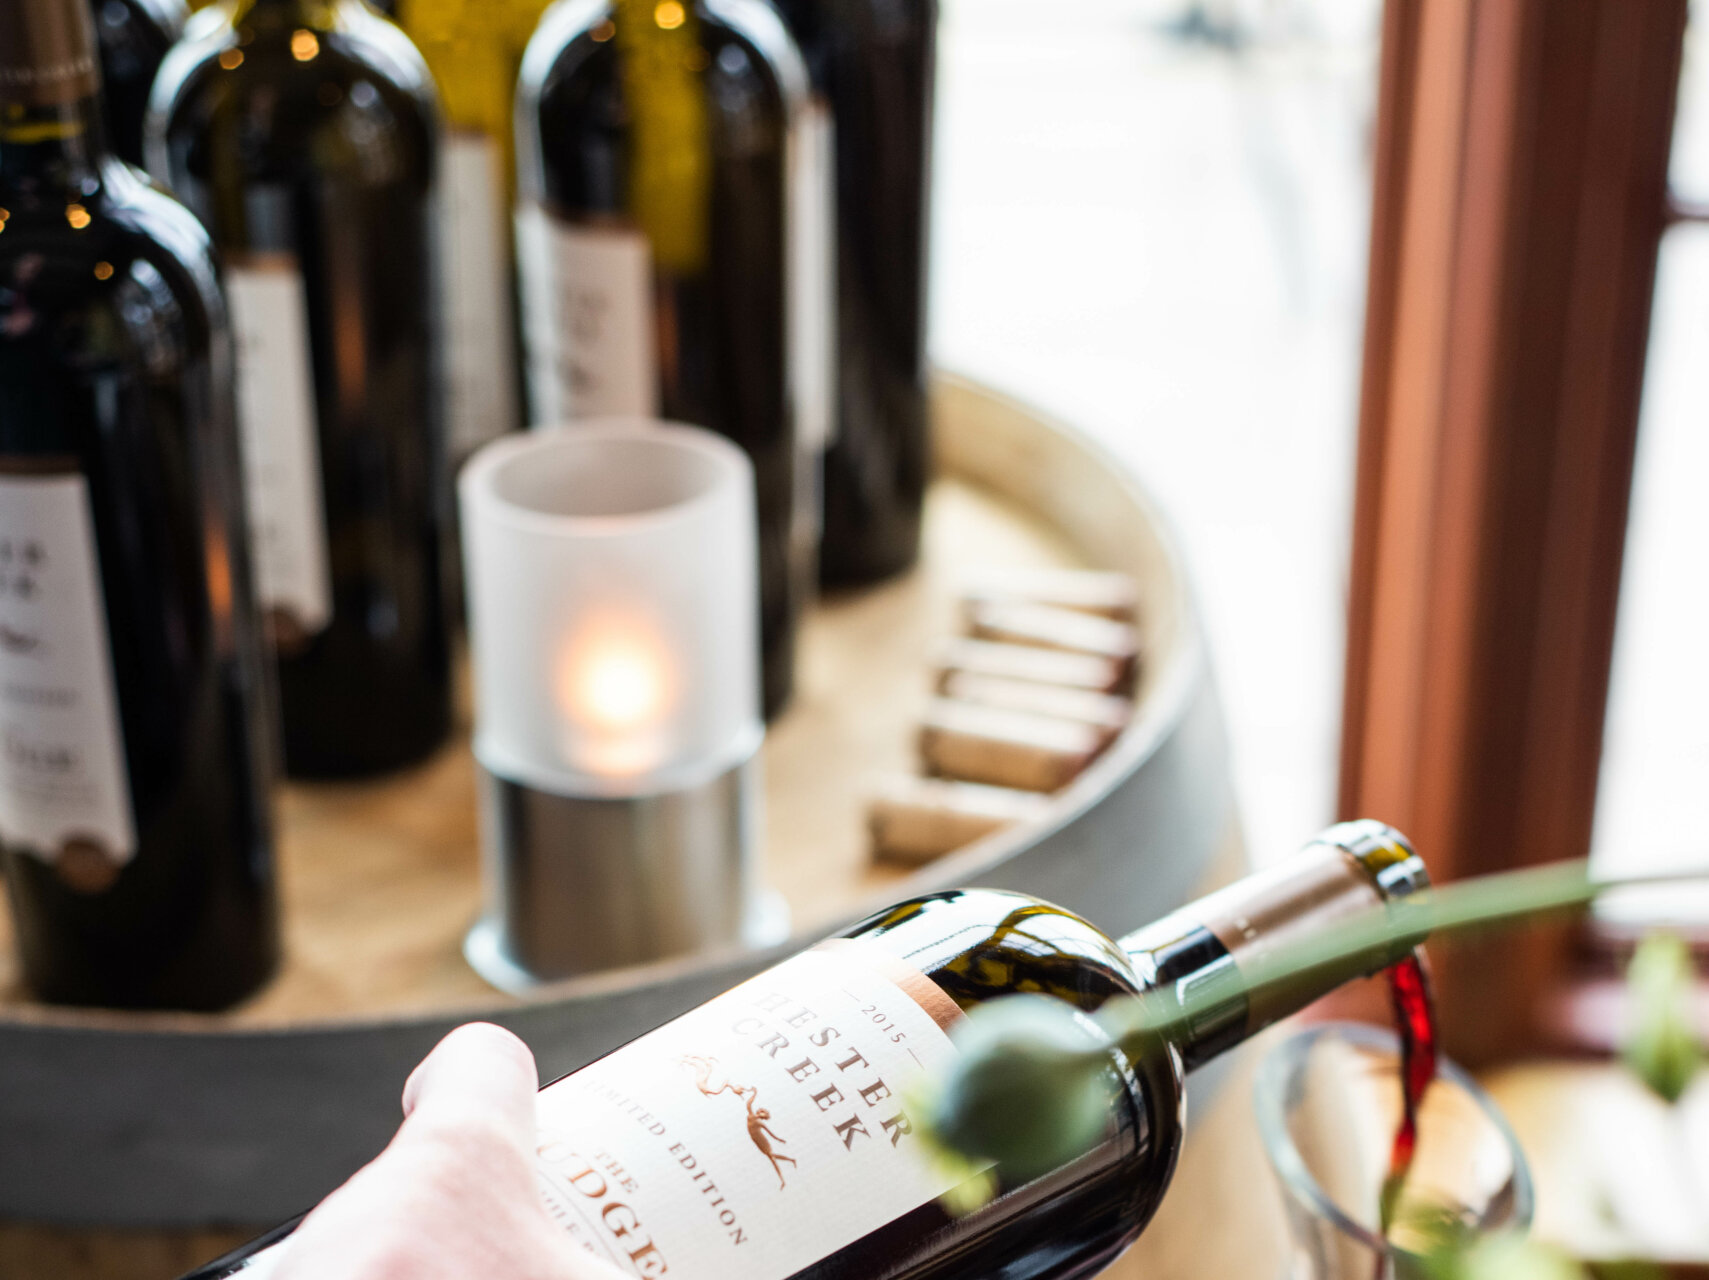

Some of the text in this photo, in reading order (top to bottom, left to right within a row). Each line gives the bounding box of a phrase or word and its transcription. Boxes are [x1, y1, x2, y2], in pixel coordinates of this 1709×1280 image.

[752, 991, 913, 1149] HESTER
[860, 1004, 907, 1044] 2015
[732, 1017, 872, 1152] CREEK
[594, 1150, 640, 1195] THE
[668, 1142, 748, 1246] EDITION
